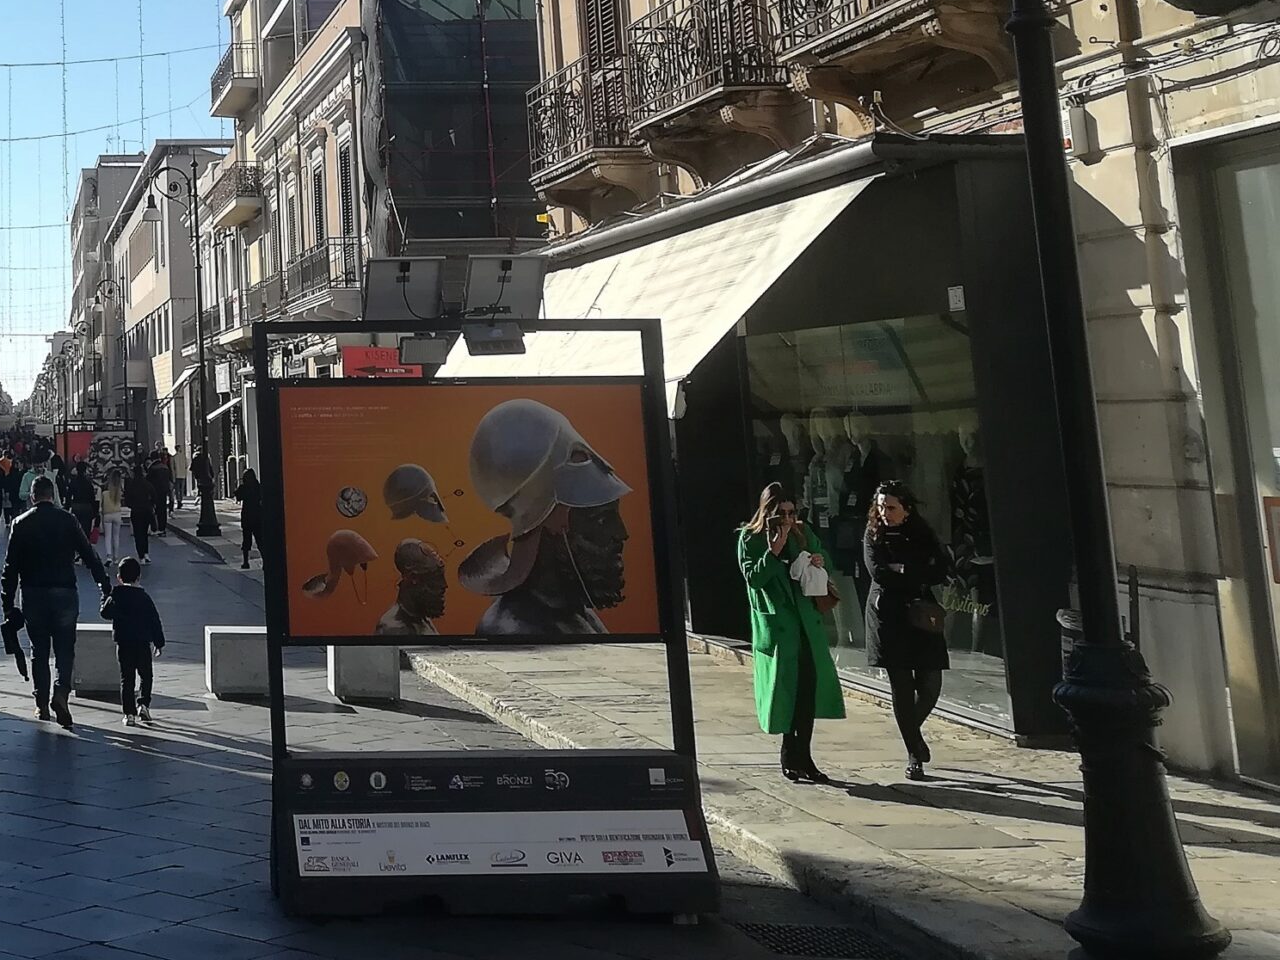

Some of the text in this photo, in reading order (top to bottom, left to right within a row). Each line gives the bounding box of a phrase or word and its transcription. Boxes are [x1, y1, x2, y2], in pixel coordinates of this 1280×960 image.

[298, 819, 311, 830] DAL
[312, 818, 330, 829] MITO
[330, 818, 347, 830] ALLA
[347, 818, 371, 829] STORIA
[546, 851, 584, 864] GIVA
